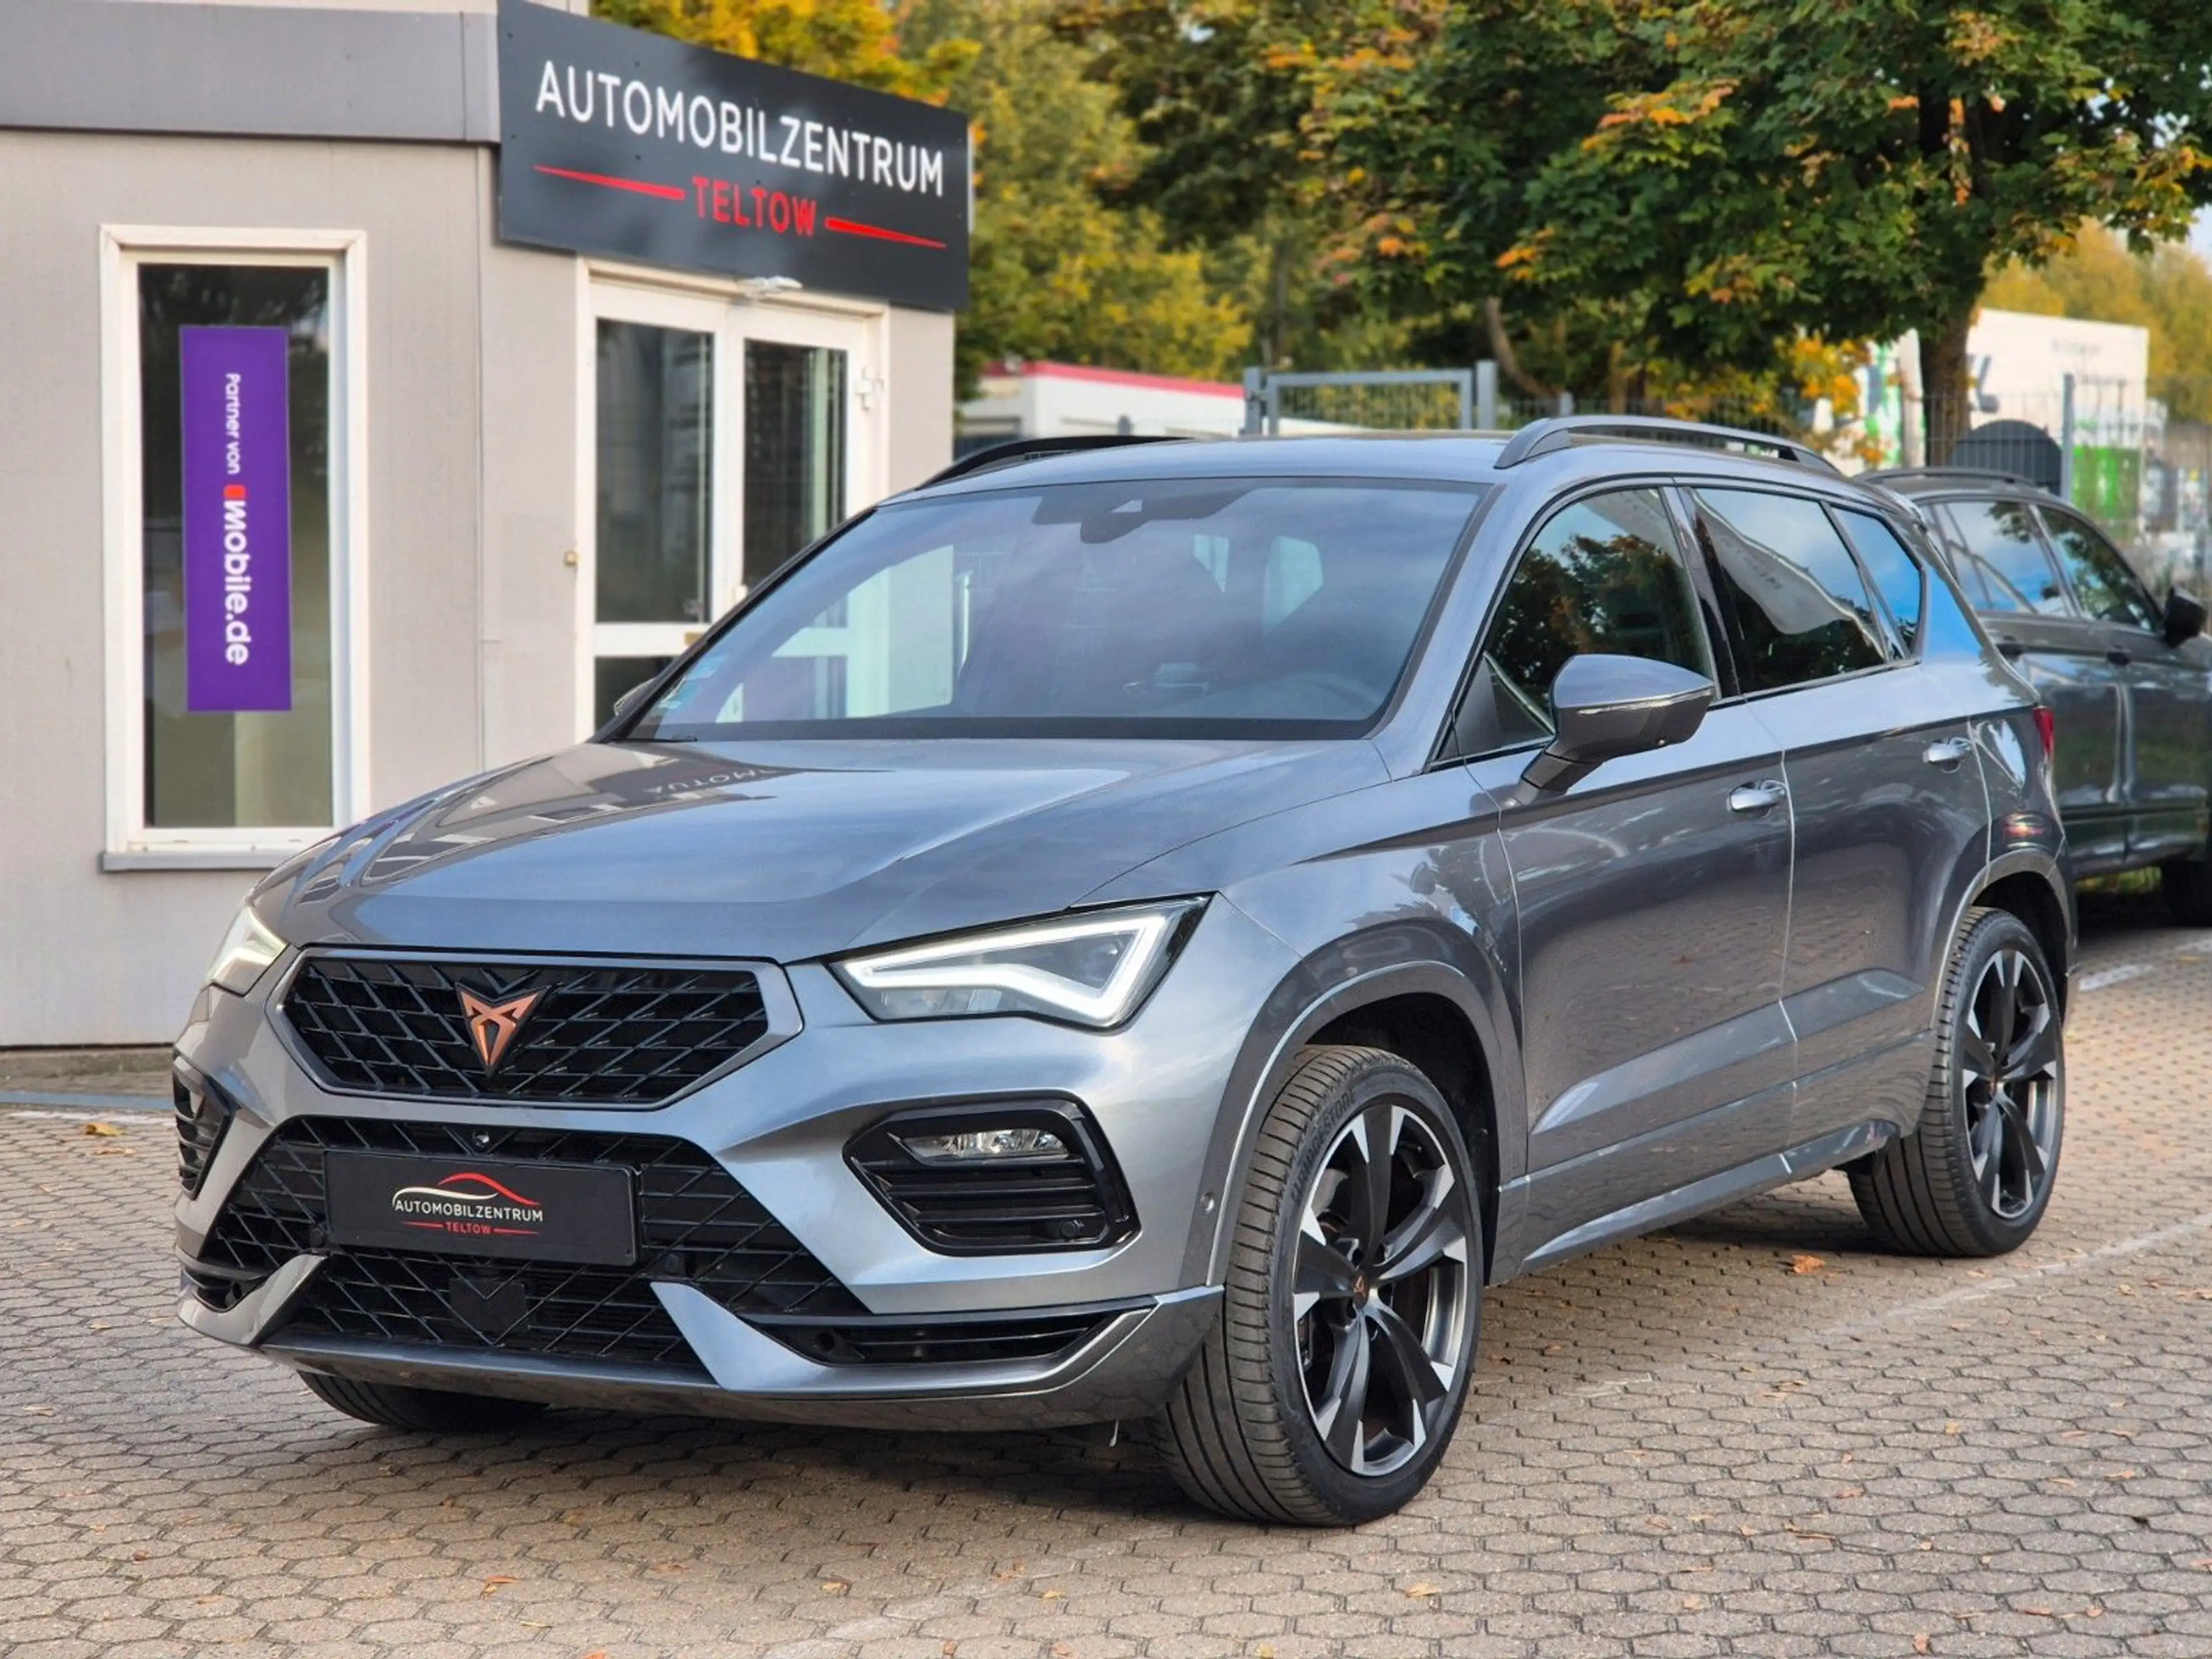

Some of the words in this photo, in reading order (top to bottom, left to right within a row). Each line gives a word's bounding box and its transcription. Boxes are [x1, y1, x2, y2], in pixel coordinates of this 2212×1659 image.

[536, 60, 944, 197] AUTOMOBILZENTRUM
[692, 176, 817, 237] TELTOW
[225, 373, 241, 438] Partner
[227, 441, 241, 475] von
[394, 1199, 544, 1222] AUTOMOBILZENTRUM
[445, 1221, 492, 1234] TELTOW
